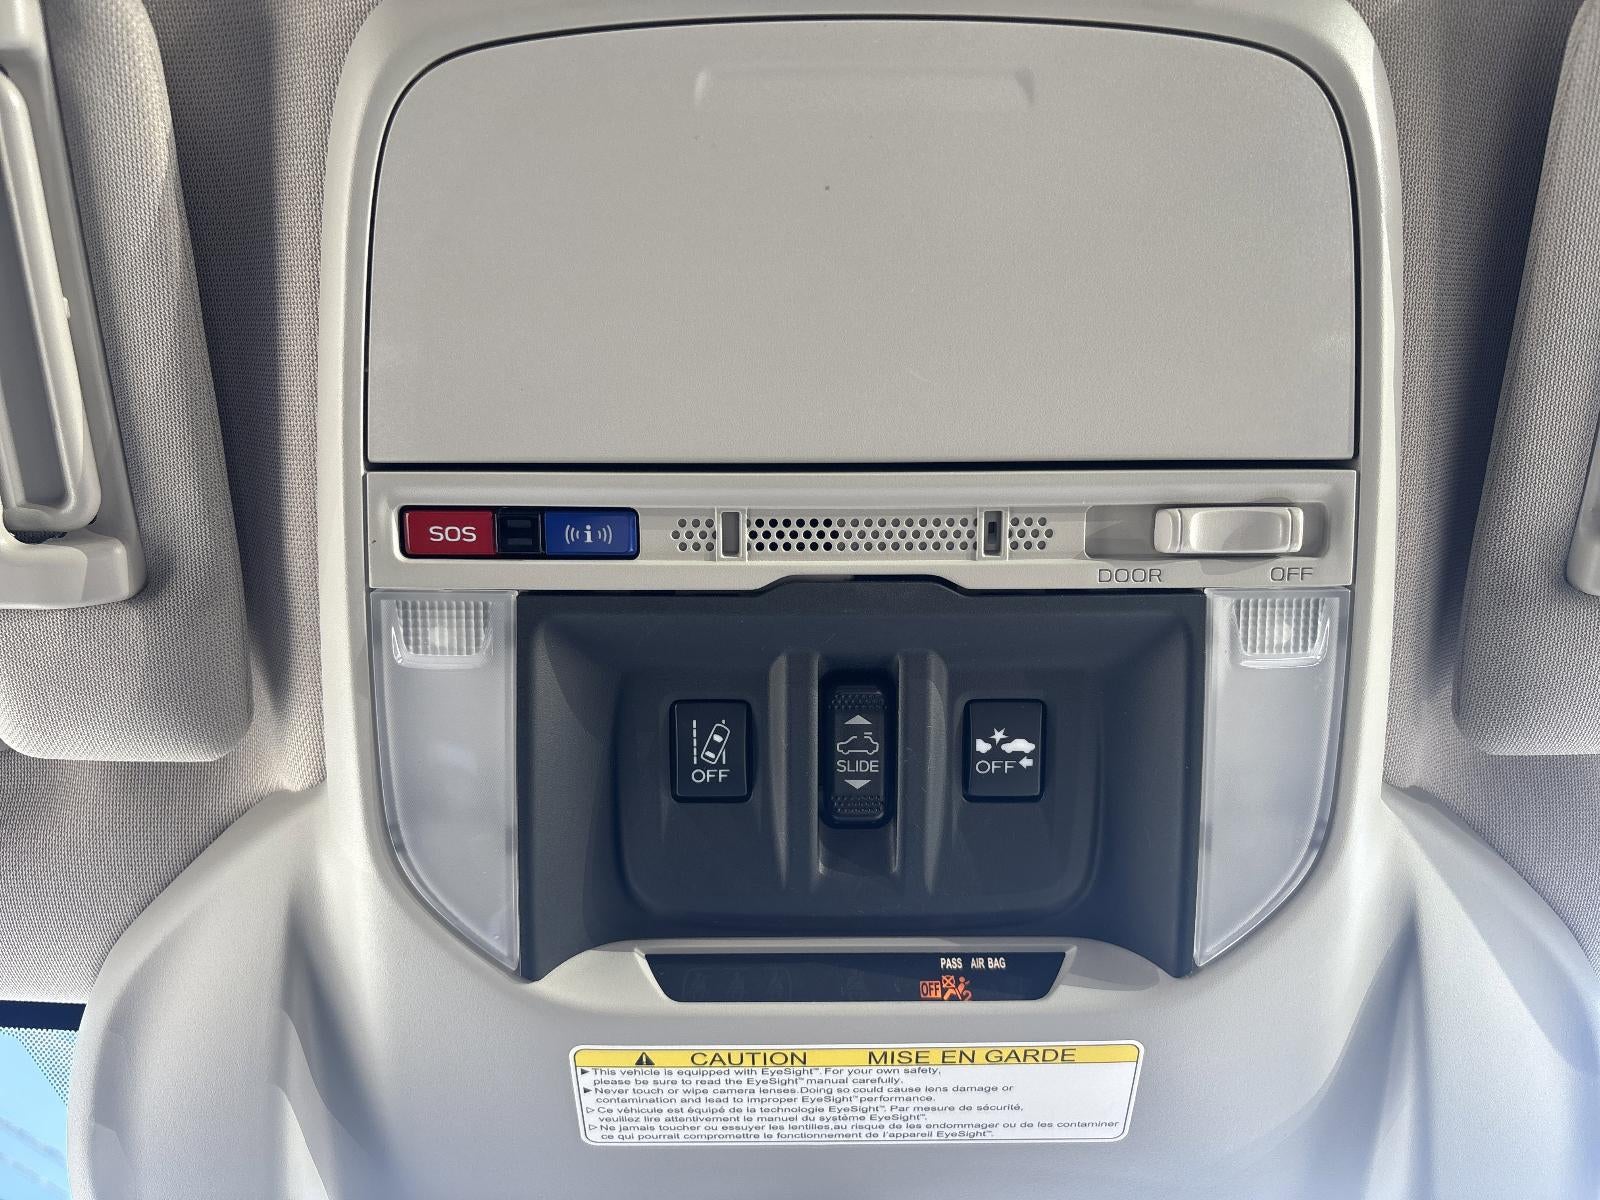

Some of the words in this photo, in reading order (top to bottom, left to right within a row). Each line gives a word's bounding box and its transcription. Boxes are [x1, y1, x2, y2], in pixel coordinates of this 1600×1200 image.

[428, 526, 476, 542] SOS
[1098, 568, 1162, 583] DOOR
[1269, 566, 1313, 582] OFF
[836, 760, 880, 772] SLIDE
[976, 760, 1016, 774] OFF
[692, 769, 730, 782] OFF
[940, 958, 963, 969] PASS
[970, 957, 986, 968] AIR
[988, 958, 1006, 968] BAG
[921, 982, 940, 996] OFF
[690, 1052, 806, 1066] CAUTION
[868, 1050, 930, 1064] MISE
[942, 1050, 976, 1064] EN
[985, 1048, 1077, 1062] GARDE
[677, 1068, 730, 1078] equipped
[734, 1068, 757, 1076] with
[904, 1067, 941, 1075] safety,
[852, 1076, 903, 1084] carefully.
[952, 1085, 998, 1093] damage
[860, 1095, 936, 1103] performance.
[688, 1106, 725, 1114] équipé
[760, 1106, 825, 1114] technologie
[819, 1114, 866, 1122] système
